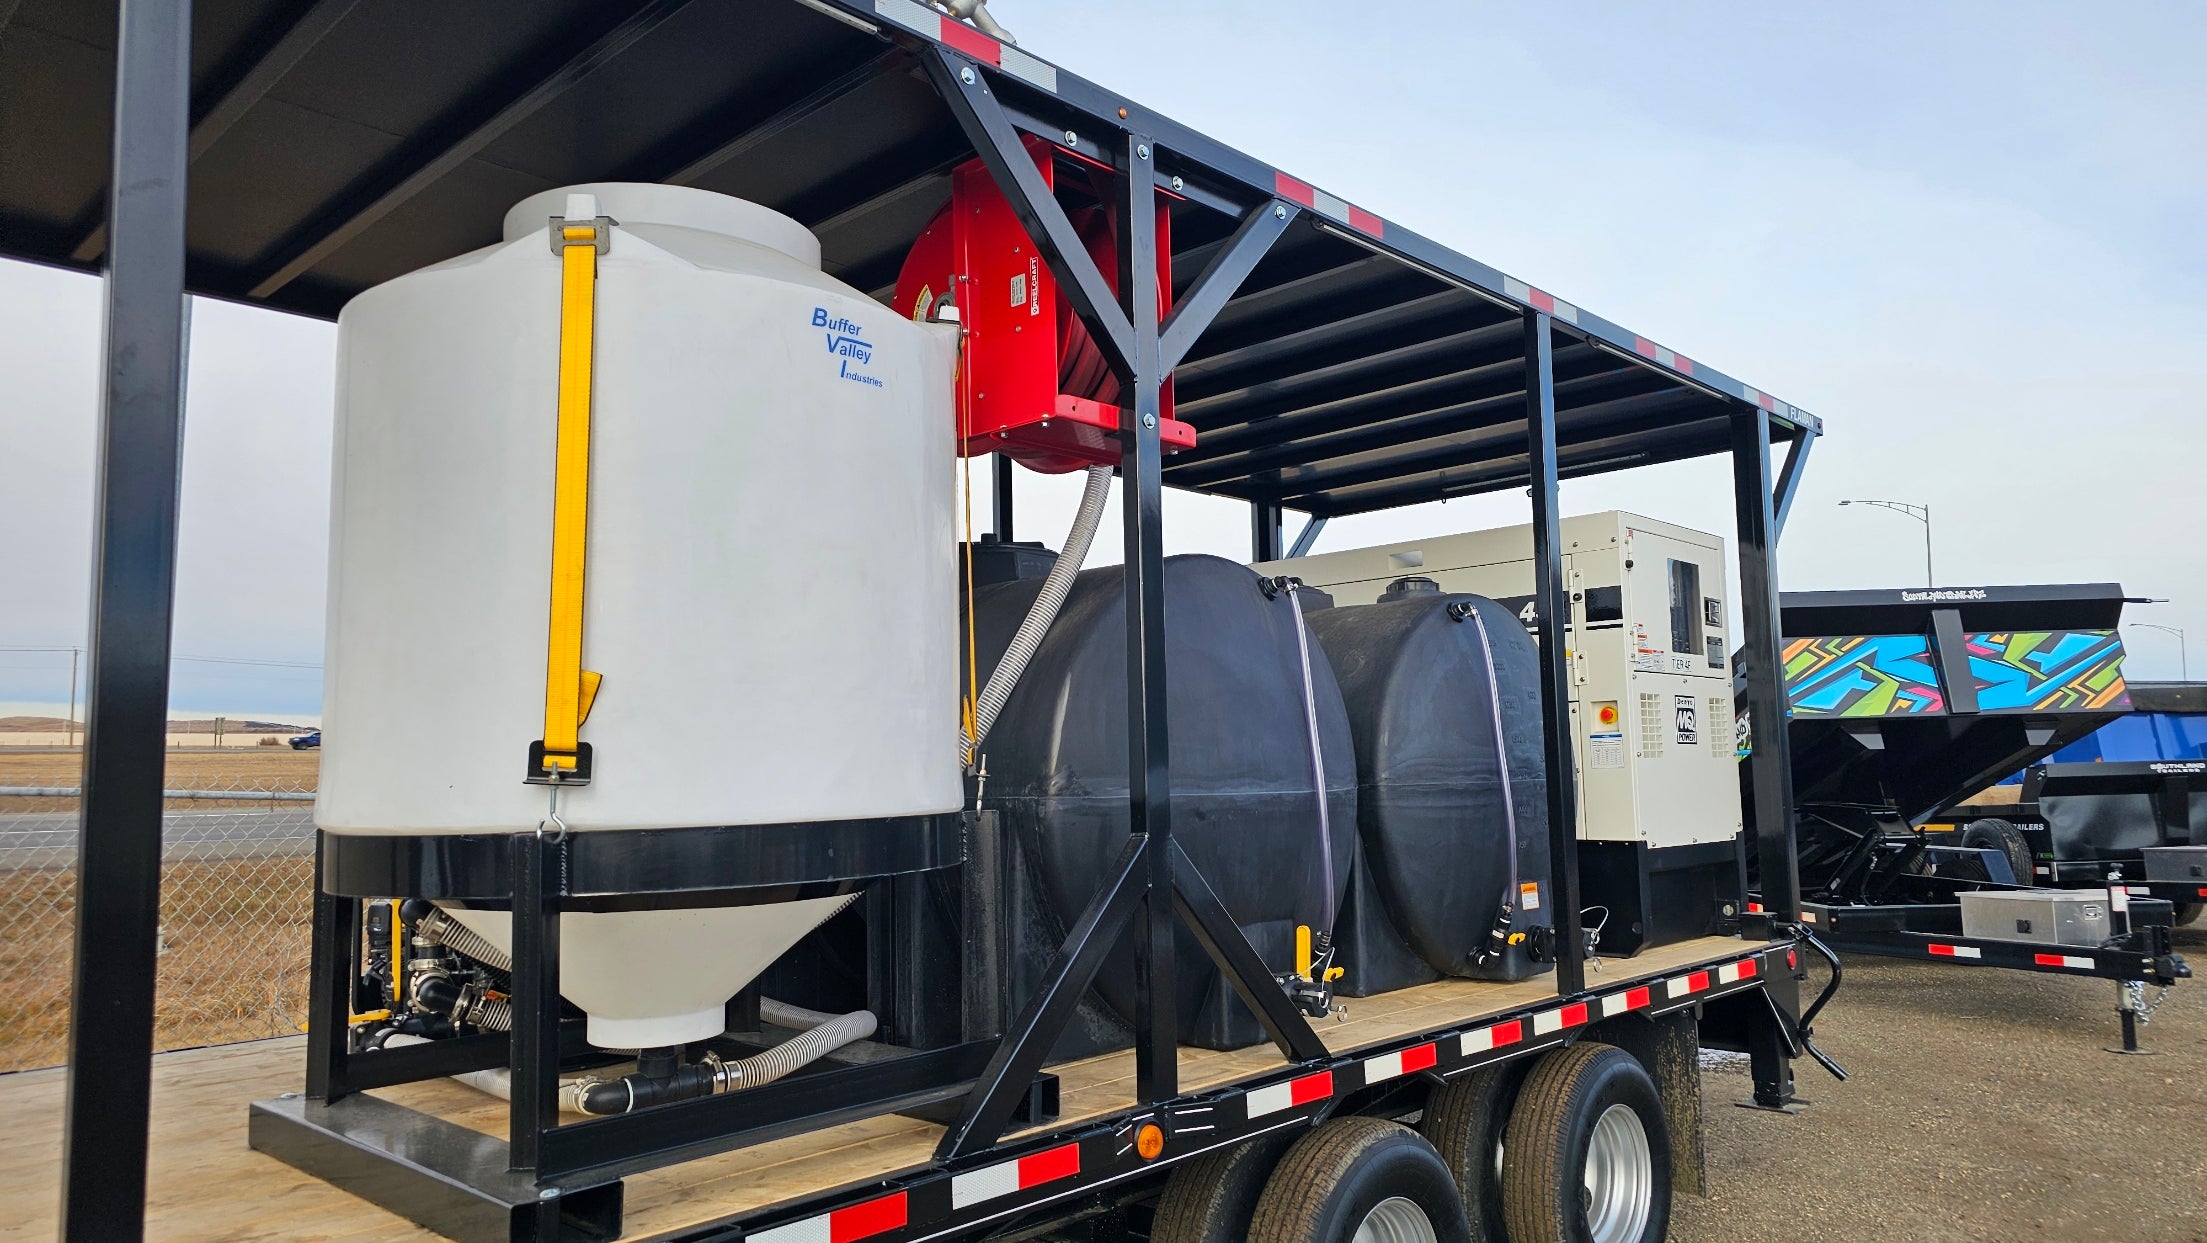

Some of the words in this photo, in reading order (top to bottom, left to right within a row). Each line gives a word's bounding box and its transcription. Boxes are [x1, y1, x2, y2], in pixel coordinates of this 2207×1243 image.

[811, 306, 862, 336] Buffer
[826, 333, 873, 365] Valley
[840, 359, 883, 388] Industries
[1678, 733, 1696, 742] POWER
